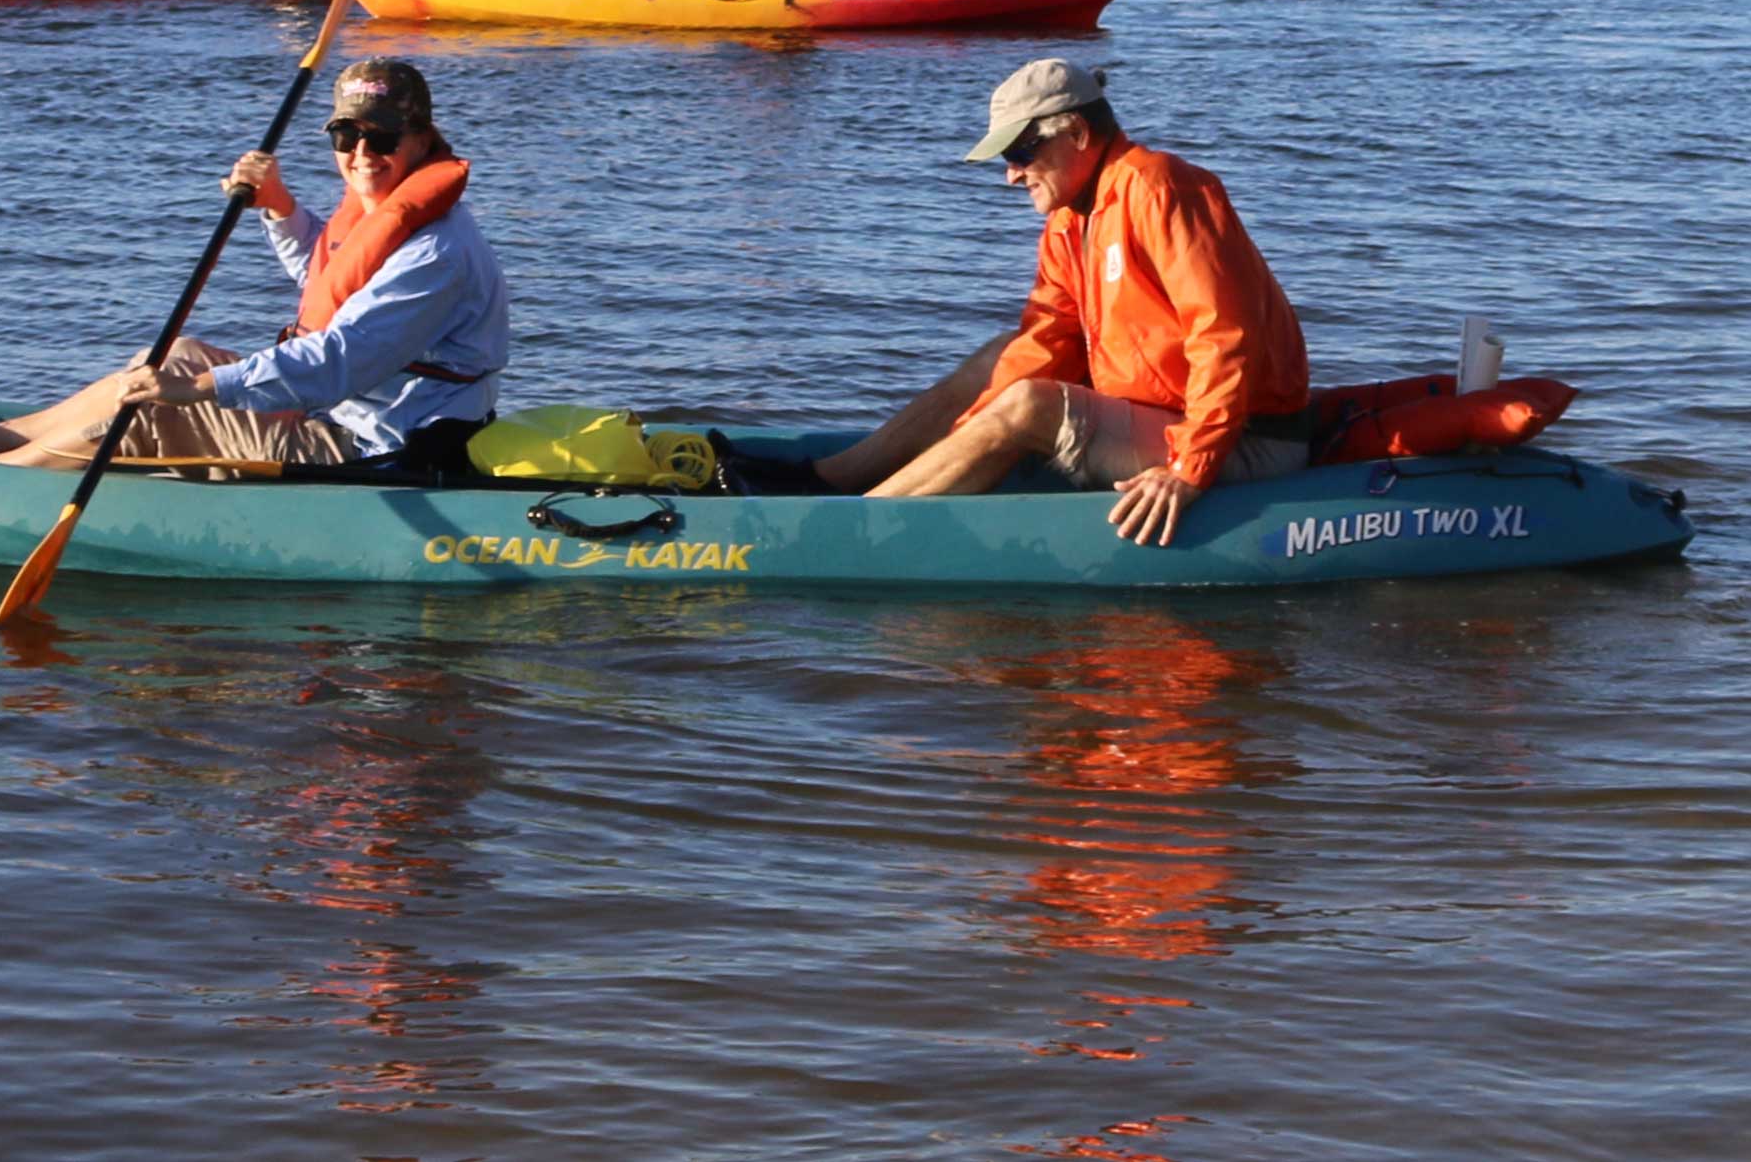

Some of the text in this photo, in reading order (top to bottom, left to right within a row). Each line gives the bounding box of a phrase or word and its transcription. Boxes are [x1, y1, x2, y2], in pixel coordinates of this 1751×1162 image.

[423, 535, 754, 570] OCEAN KAYAK
[1286, 505, 1529, 557] MALIBU TWO XL
